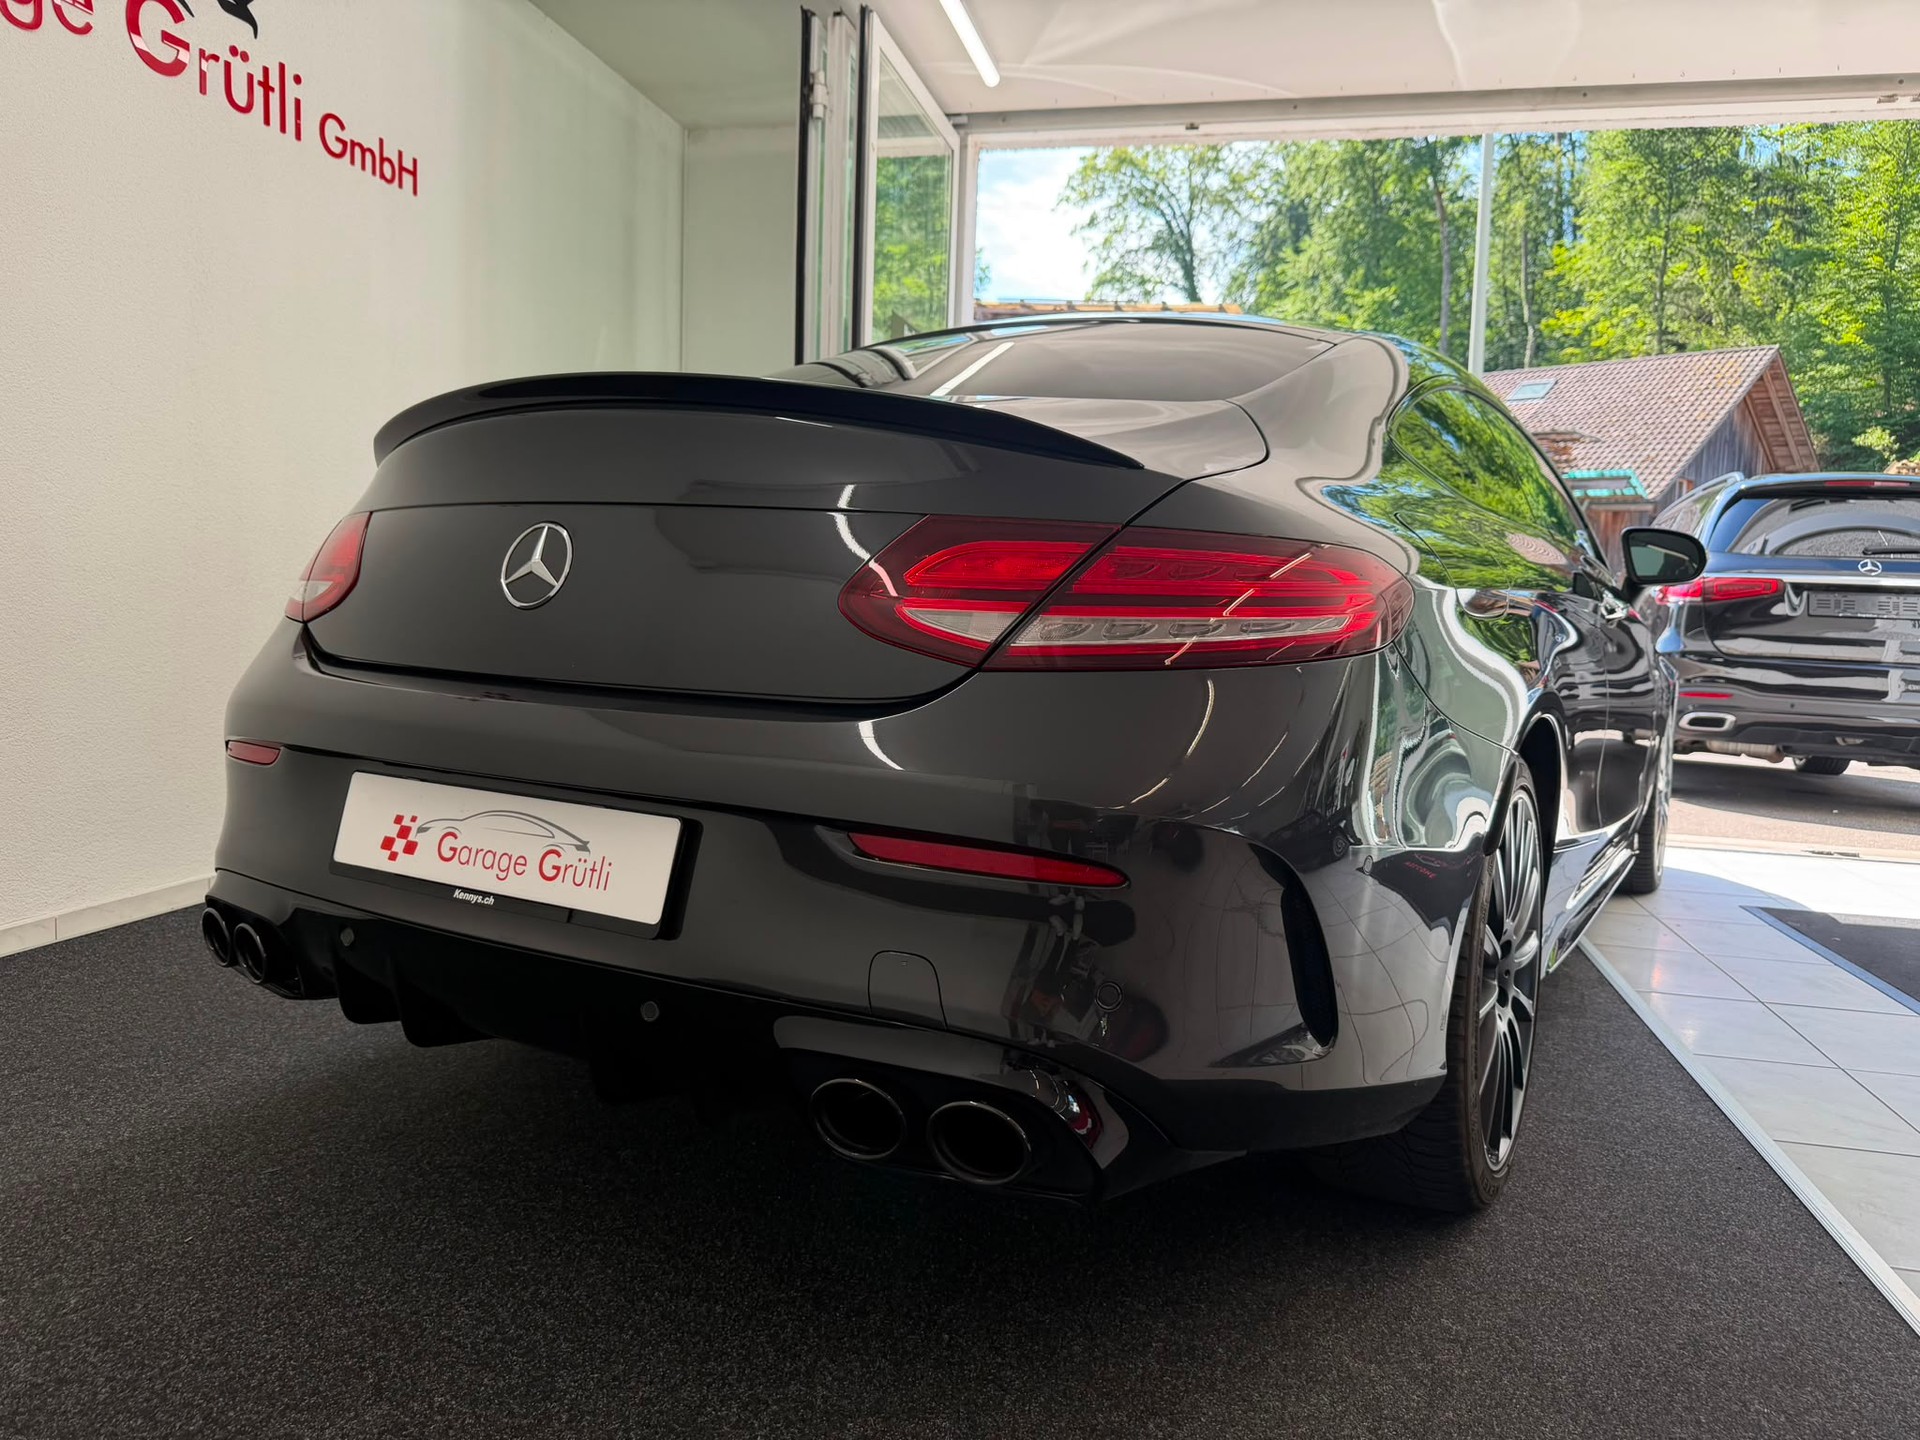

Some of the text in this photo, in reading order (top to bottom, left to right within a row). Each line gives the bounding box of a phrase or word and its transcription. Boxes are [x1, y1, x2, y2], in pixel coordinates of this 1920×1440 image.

[125, 0, 303, 143] Grütli
[318, 112, 419, 197] GmbH
[436, 831, 614, 892] Garage Grütli
[453, 888, 495, 906] Kennys.ch
